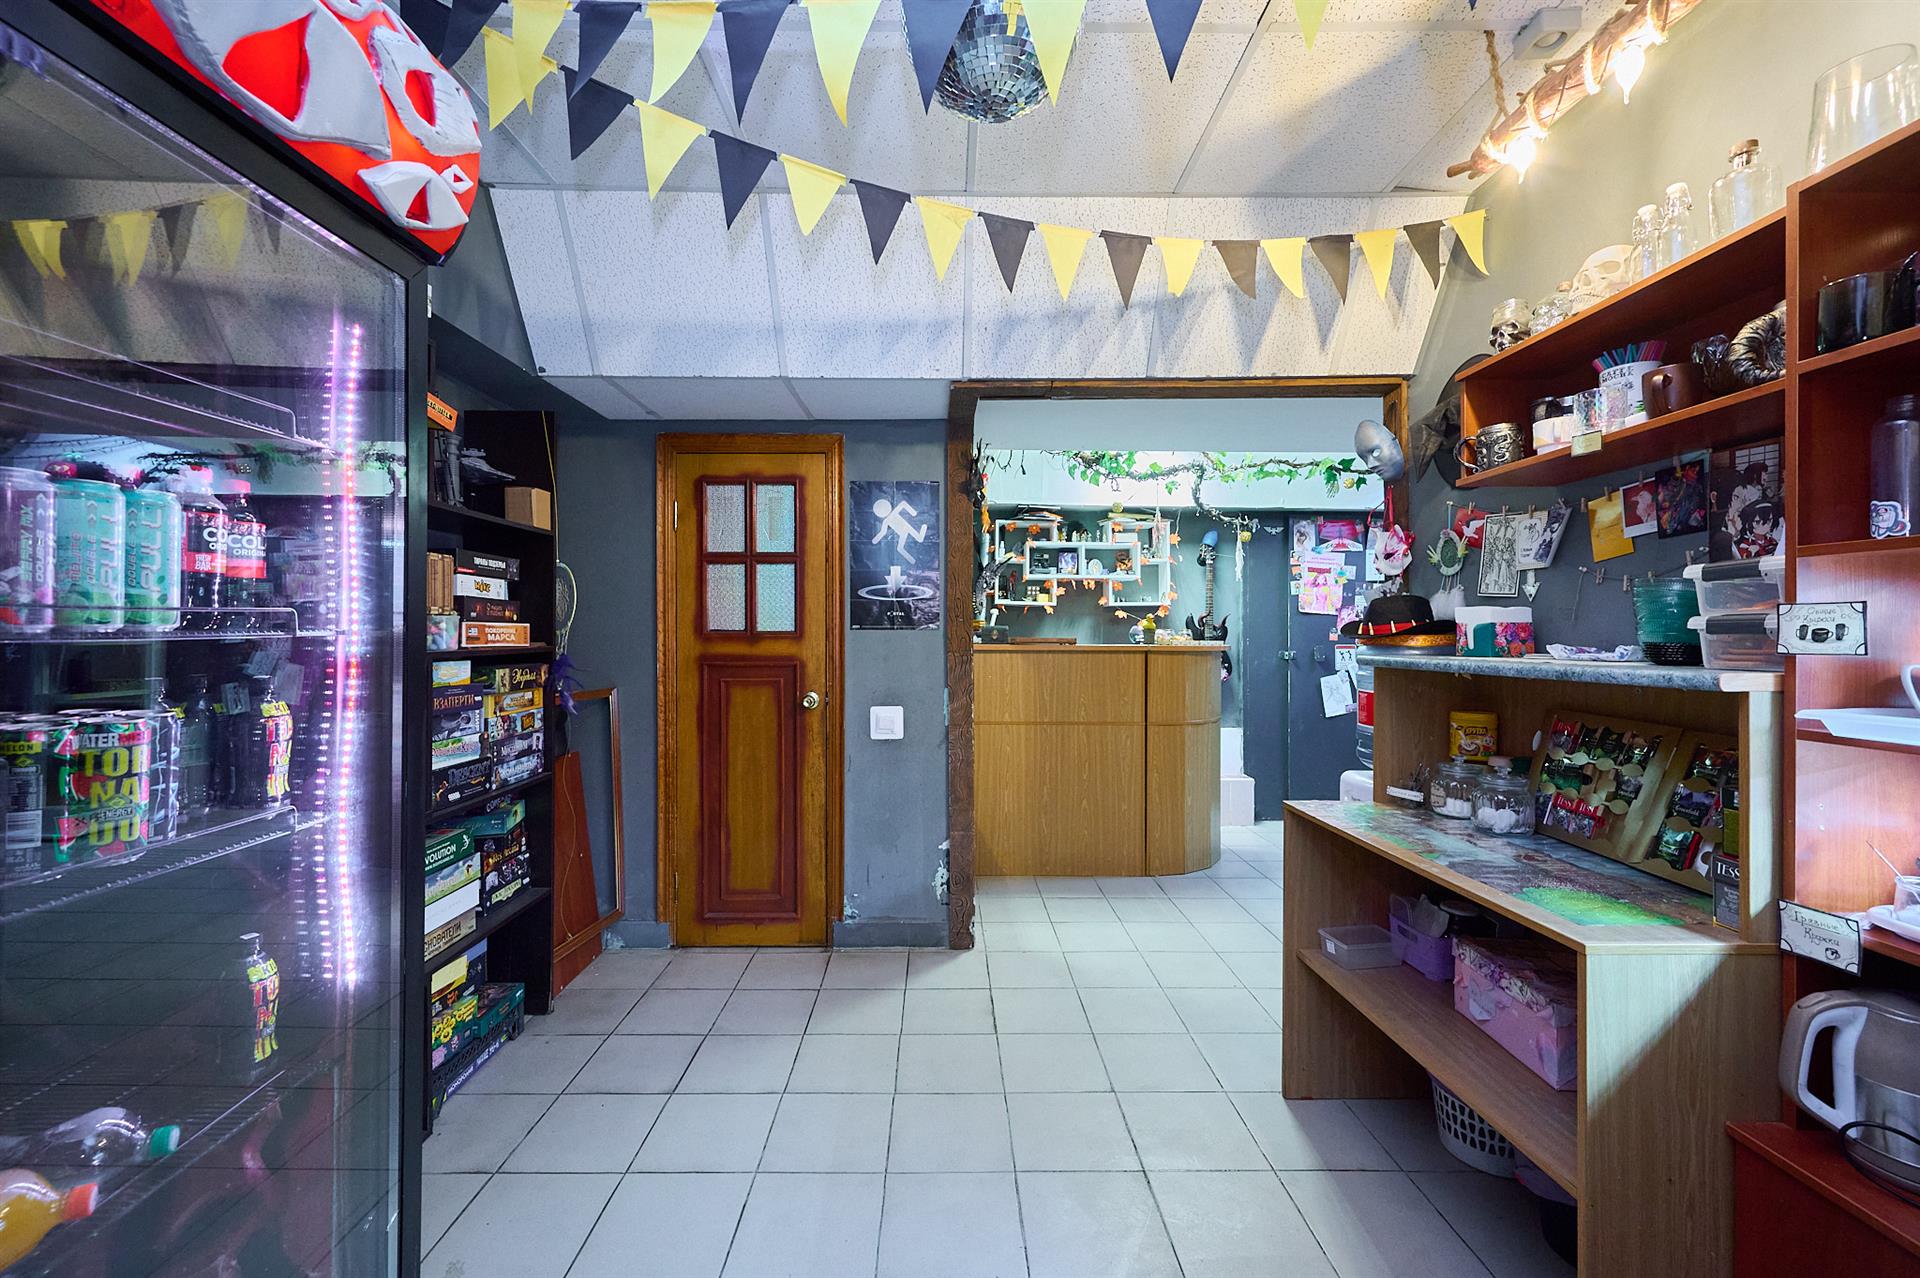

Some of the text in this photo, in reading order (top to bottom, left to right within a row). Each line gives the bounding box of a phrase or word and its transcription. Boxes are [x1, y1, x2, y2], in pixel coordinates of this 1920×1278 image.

[203, 527, 228, 542] CO
[228, 534, 267, 550] COL
[432, 694, 474, 710] ВЗАПЕРТИ
[425, 844, 457, 865] VOLUTION
